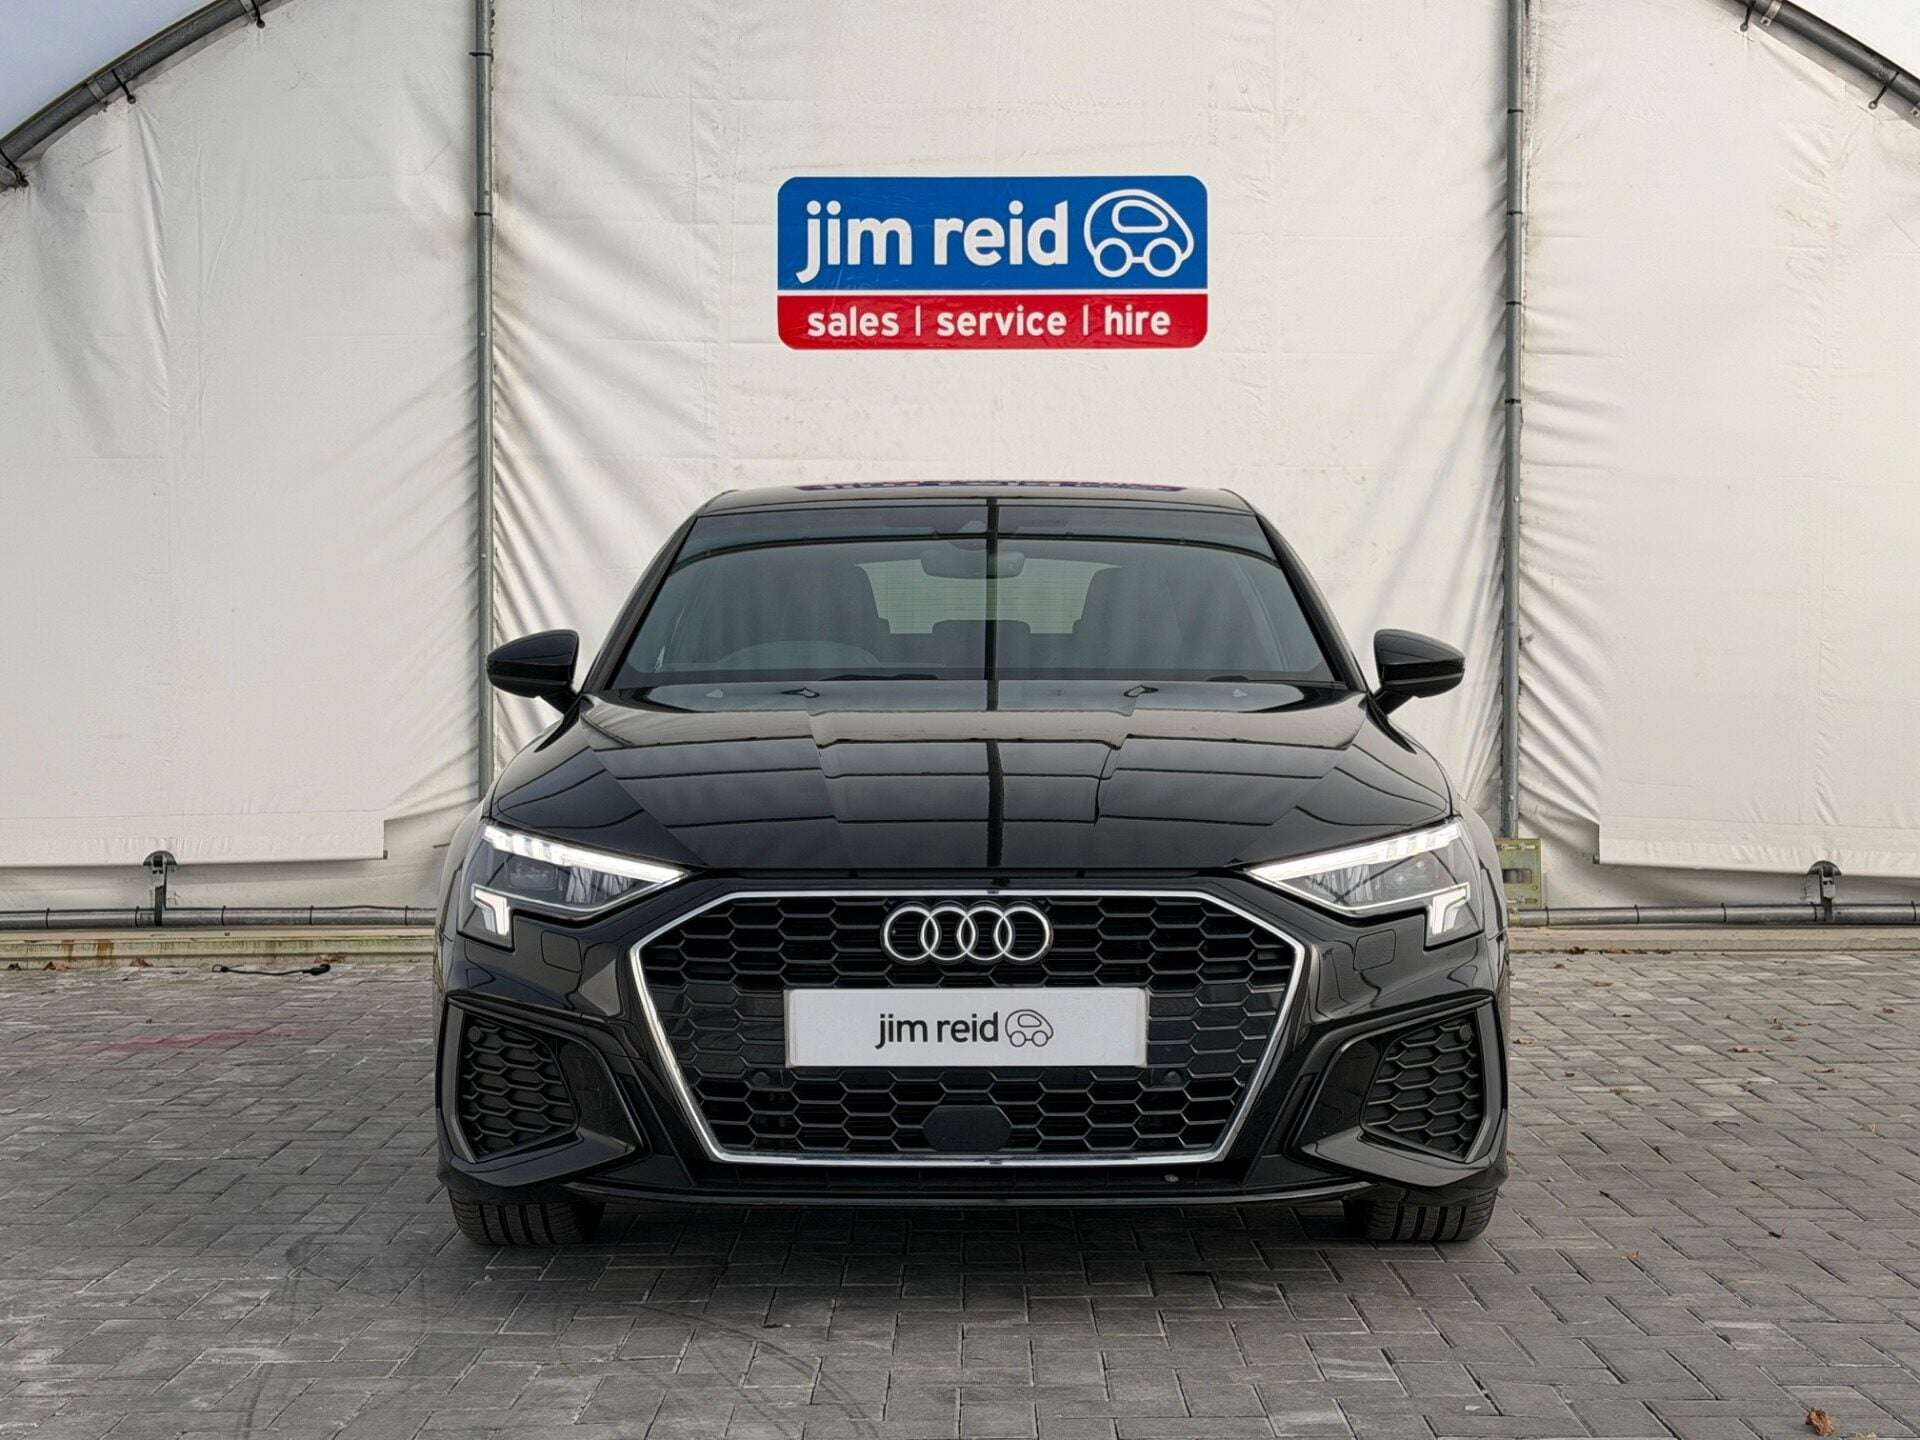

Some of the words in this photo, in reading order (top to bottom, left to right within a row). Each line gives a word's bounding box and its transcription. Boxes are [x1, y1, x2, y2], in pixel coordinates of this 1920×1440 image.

[795, 200, 913, 284] jim
[933, 199, 1069, 266] reid
[807, 305, 900, 337] sales
[936, 304, 1067, 336] service
[1104, 304, 1171, 336] hire
[874, 1013, 929, 1050] jim
[936, 1011, 999, 1043] reid
